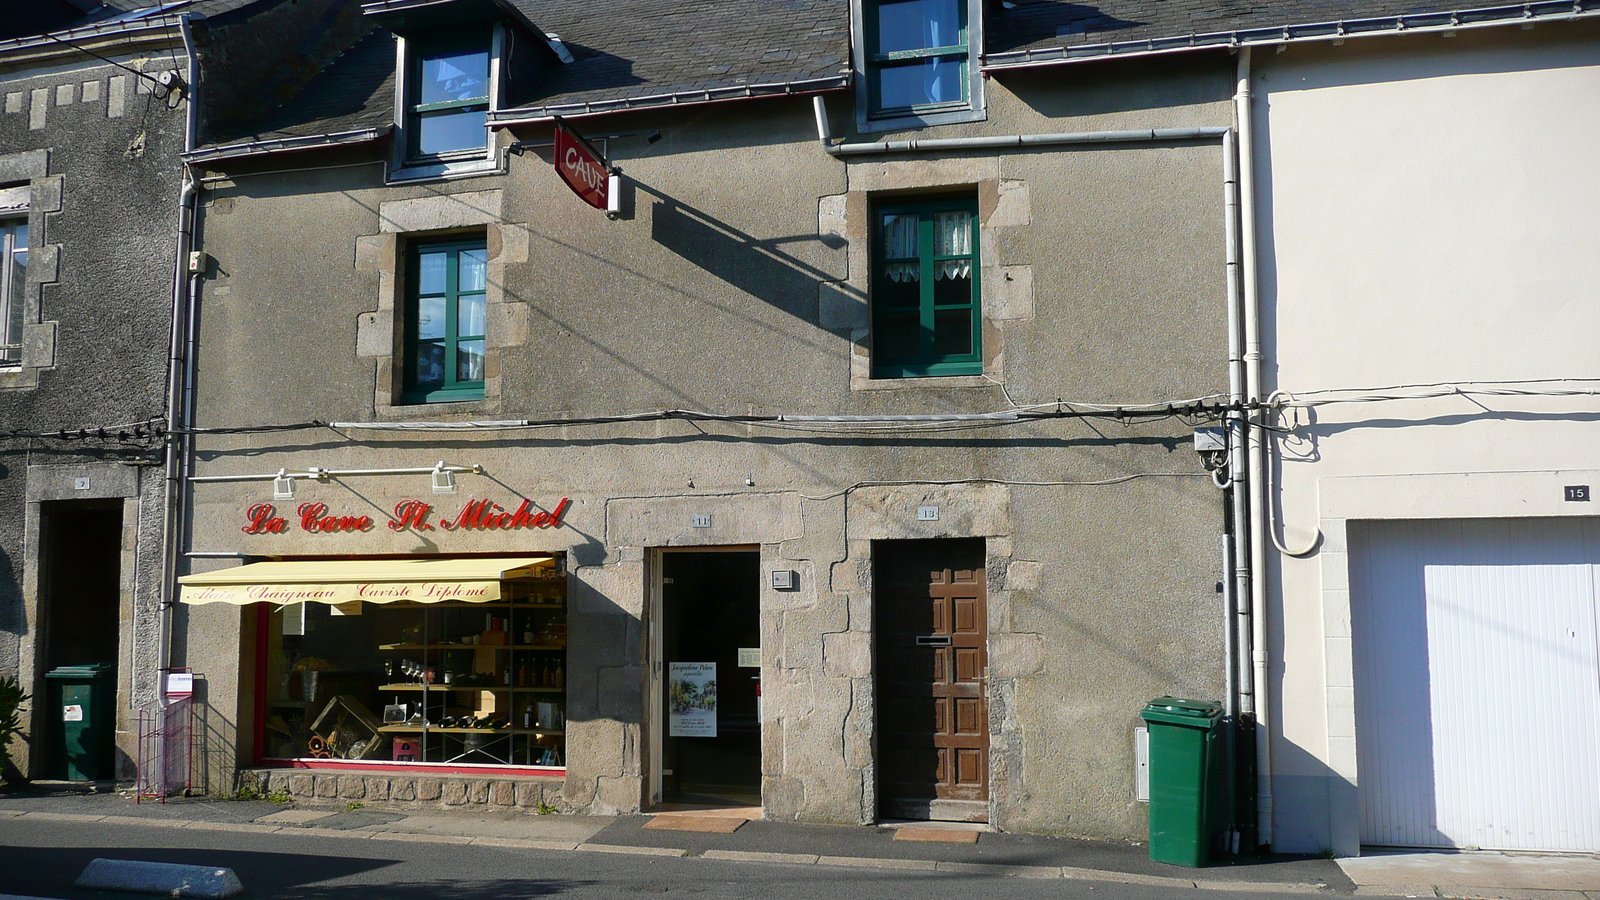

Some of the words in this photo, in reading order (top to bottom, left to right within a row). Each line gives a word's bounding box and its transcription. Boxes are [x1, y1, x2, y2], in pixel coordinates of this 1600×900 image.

[1570, 489, 1584, 498] 15
[241, 503, 285, 533] La
[297, 501, 371, 531] Cave
[440, 497, 568, 530] Michel
[697, 517, 707, 525] 11
[246, 586, 335, 604] Chaigneau
[356, 583, 413, 597] Caviste
